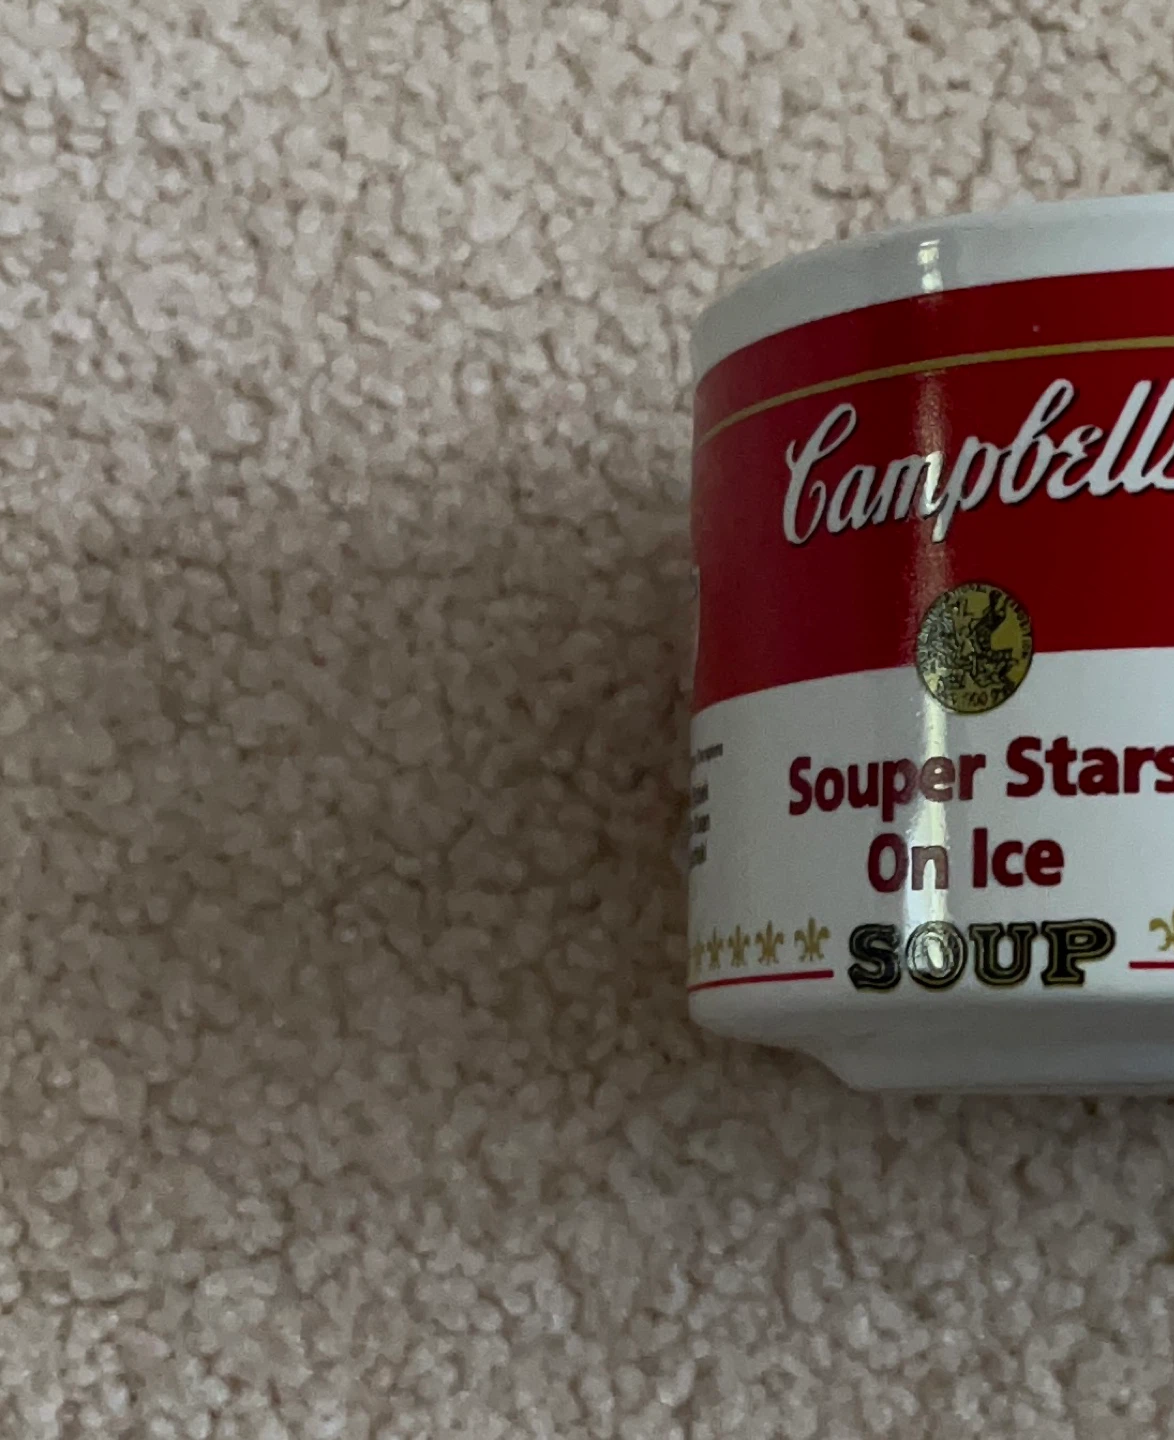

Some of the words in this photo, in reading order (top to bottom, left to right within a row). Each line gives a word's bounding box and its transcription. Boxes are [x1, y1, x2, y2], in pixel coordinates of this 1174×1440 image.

[788, 753, 986, 821] Souper
[867, 833, 949, 893] On
[972, 828, 1065, 888] Ice
[848, 919, 1116, 991] SOUP
